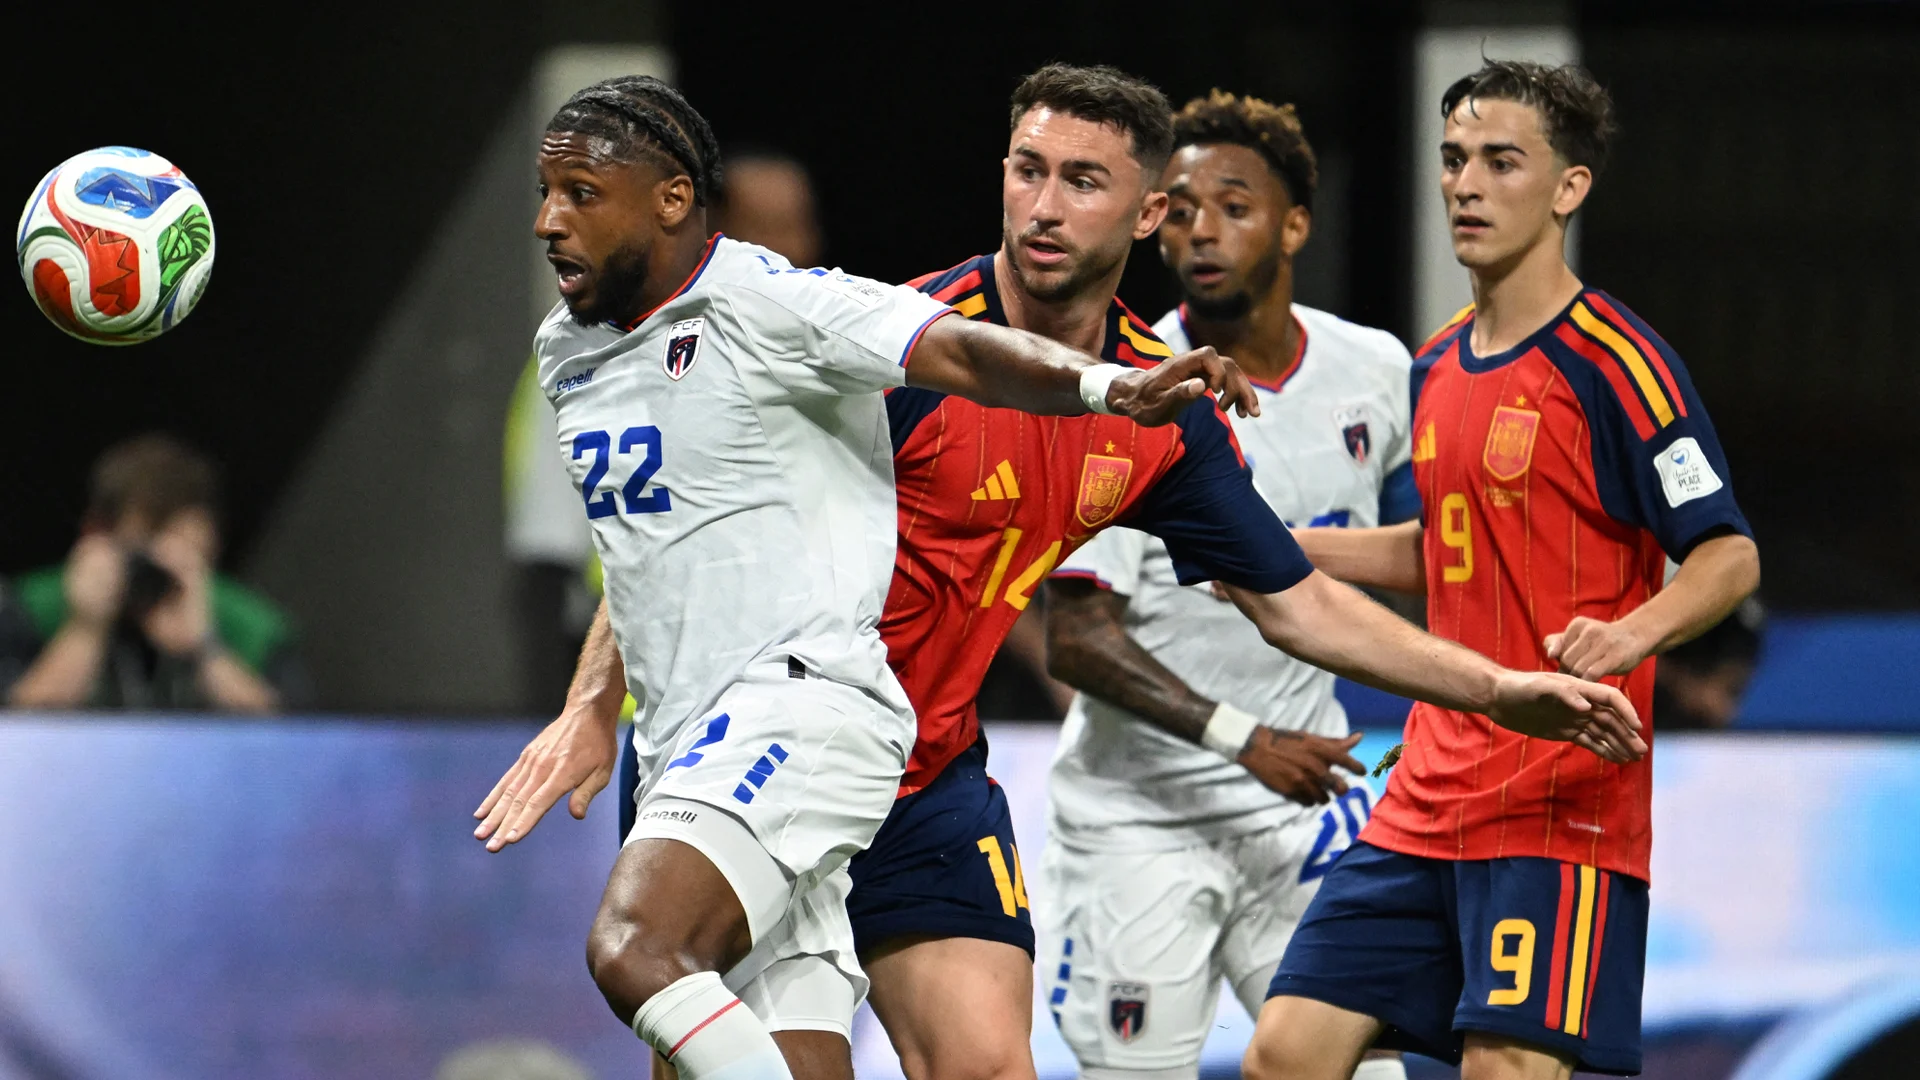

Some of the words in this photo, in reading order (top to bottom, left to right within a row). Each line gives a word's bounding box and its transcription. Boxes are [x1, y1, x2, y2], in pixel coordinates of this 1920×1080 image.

[671, 320, 702, 332] FCF
[556, 367, 597, 391] capelli
[572, 425, 672, 520] 22
[1441, 493, 1474, 582] 9
[1487, 919, 1536, 1005] 9
